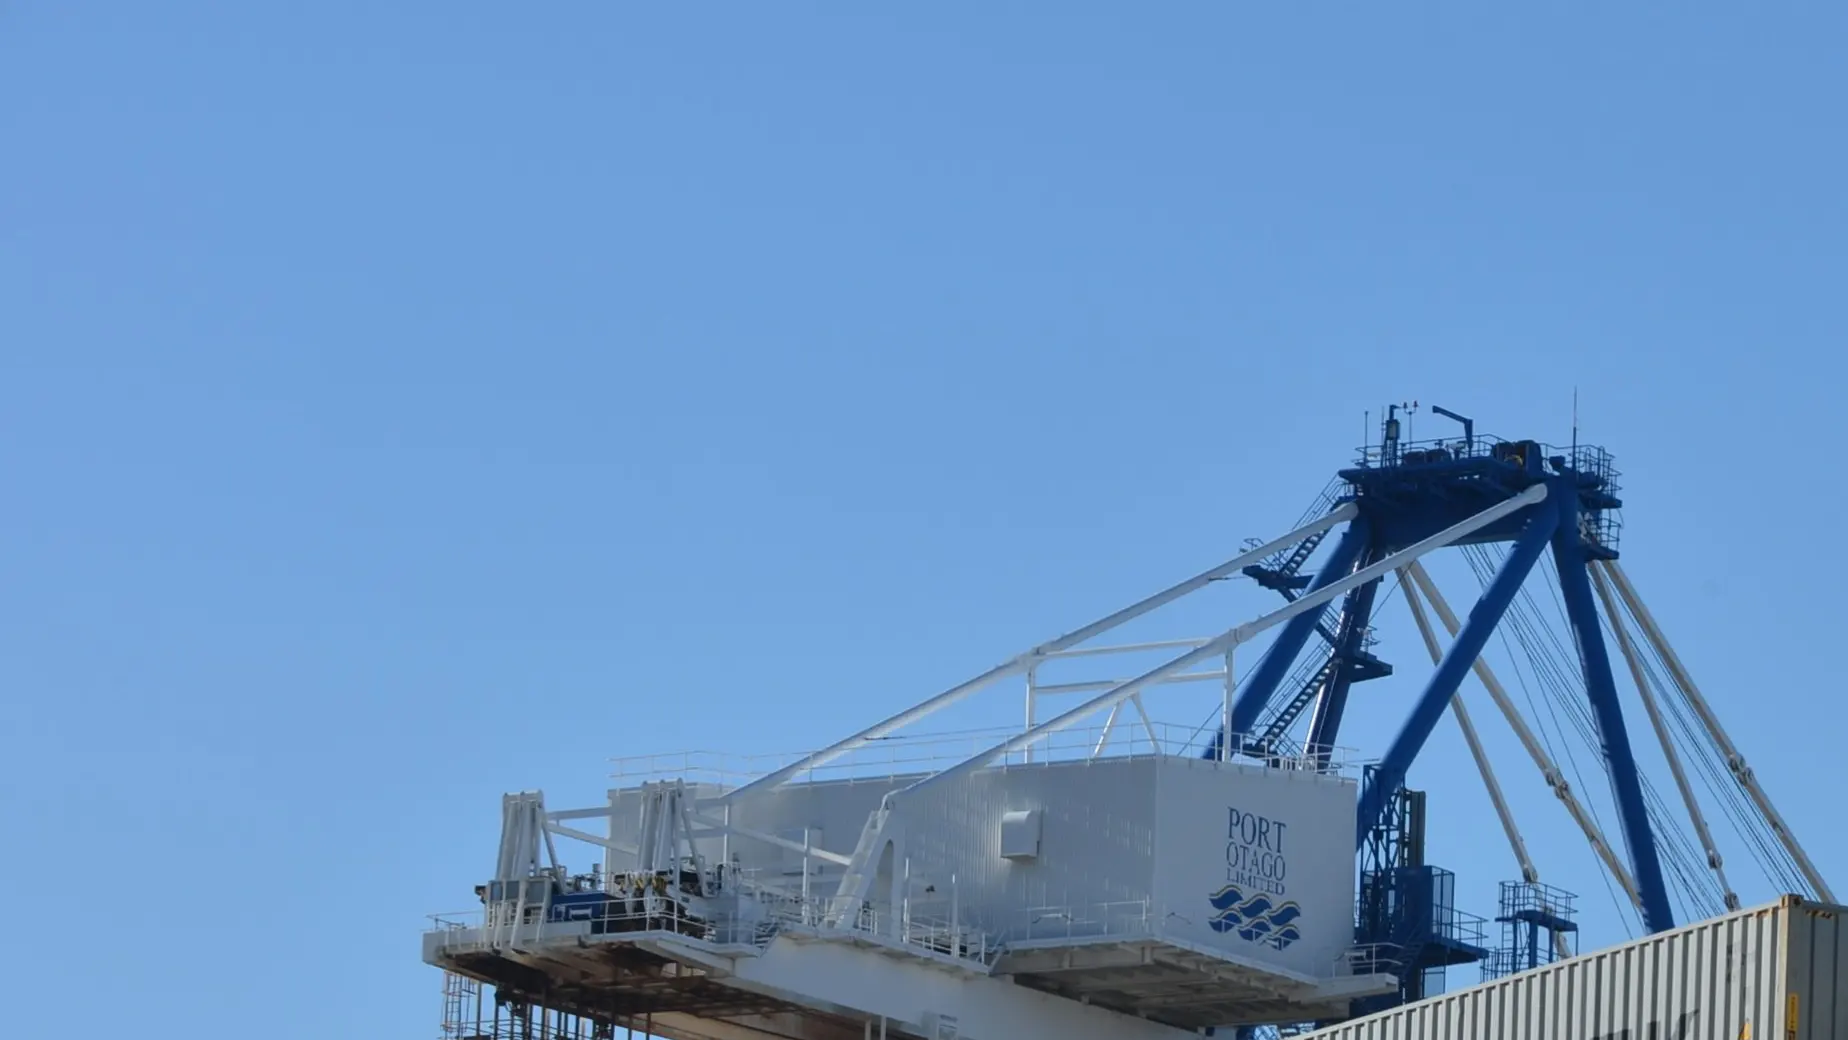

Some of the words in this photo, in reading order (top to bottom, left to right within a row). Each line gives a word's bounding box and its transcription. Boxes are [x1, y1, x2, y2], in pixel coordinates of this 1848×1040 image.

[1227, 805, 1287, 854] PORT
[1226, 841, 1286, 882] OTAGO
[1227, 867, 1285, 896] LIMITED
